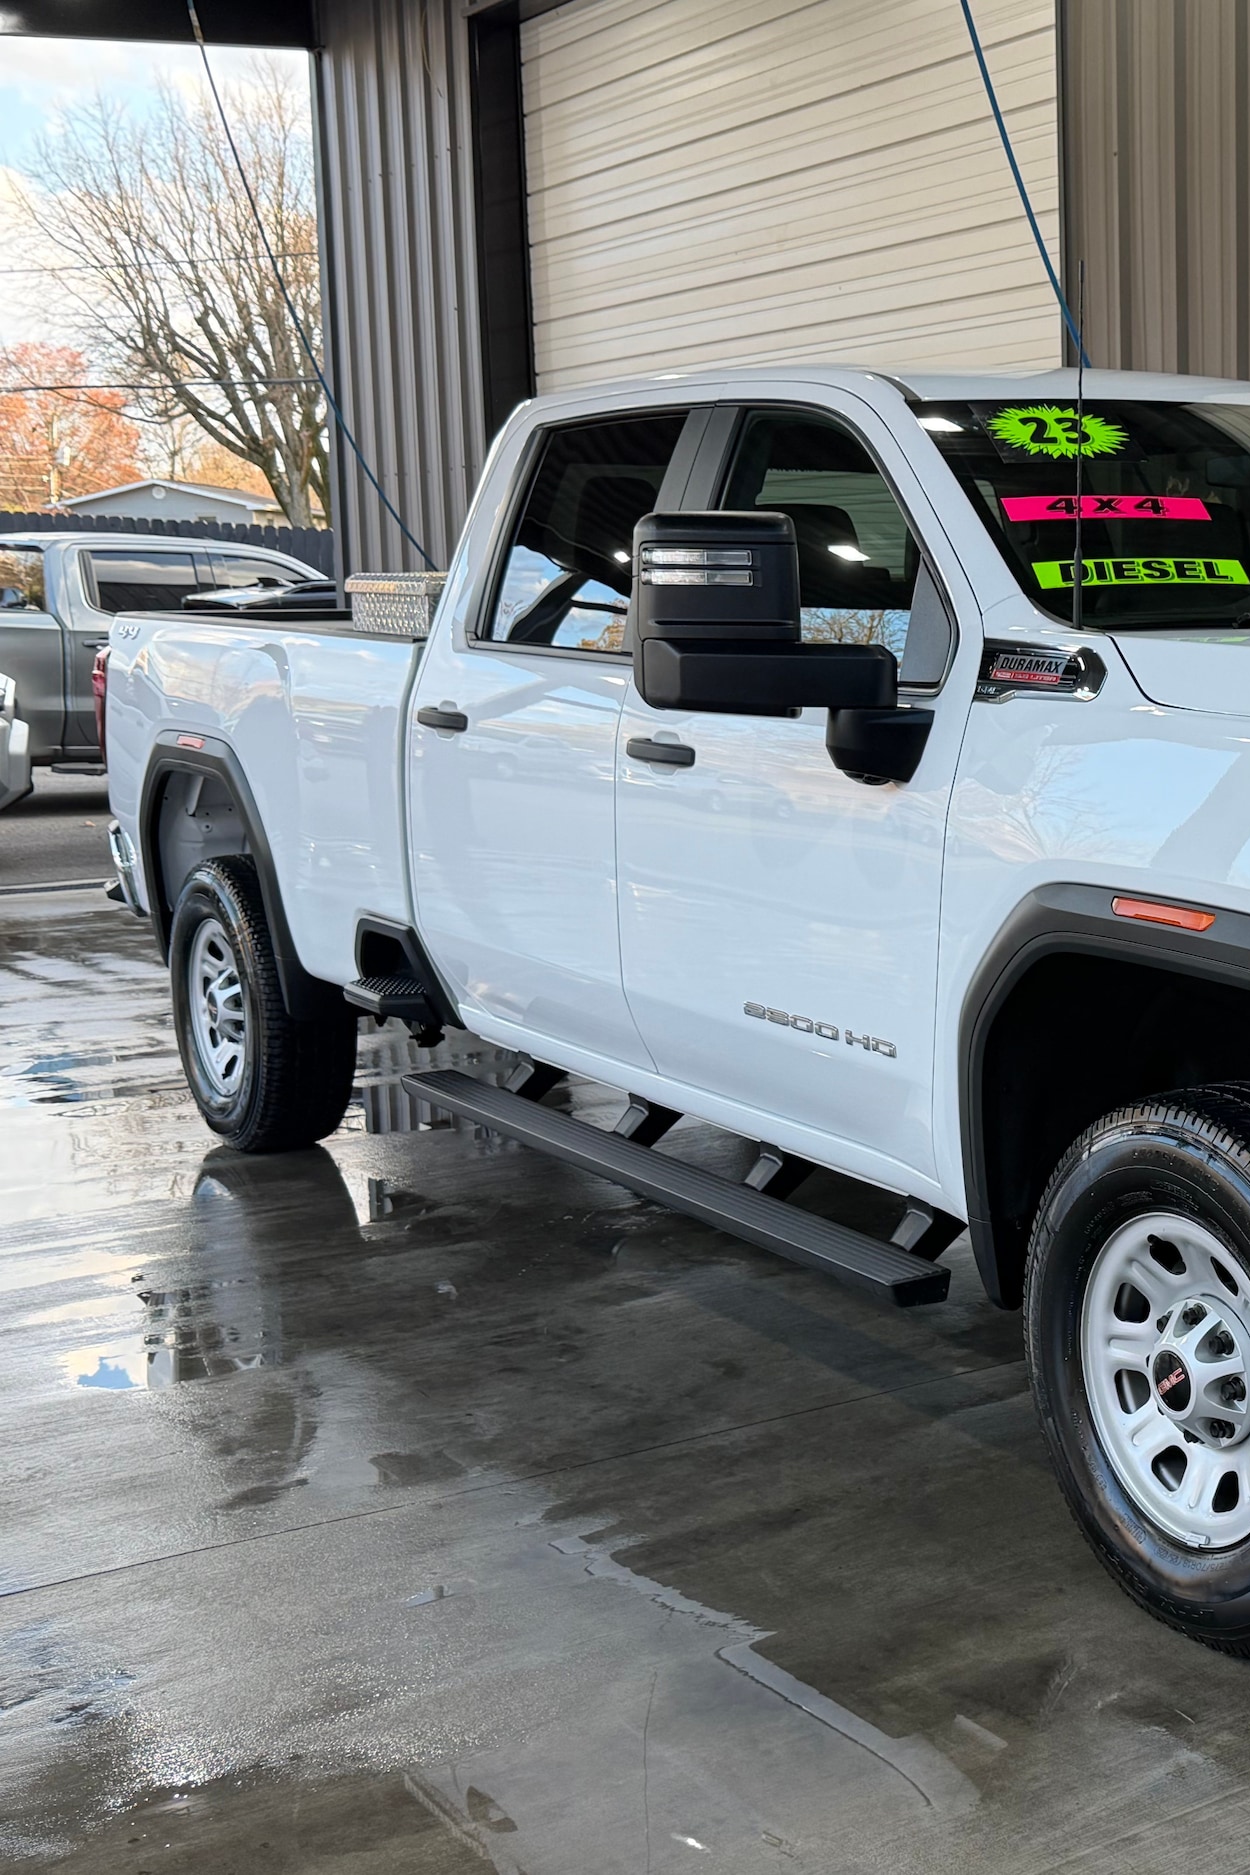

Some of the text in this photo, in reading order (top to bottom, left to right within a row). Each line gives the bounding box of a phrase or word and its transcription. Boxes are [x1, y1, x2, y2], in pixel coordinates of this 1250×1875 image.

[1018, 416, 1093, 446] 23
[1059, 559, 1234, 584] DIESEL
[999, 656, 1064, 674] DURAMAX
[845, 1029, 897, 1059] HD
[1157, 1367, 1186, 1396] GMC
